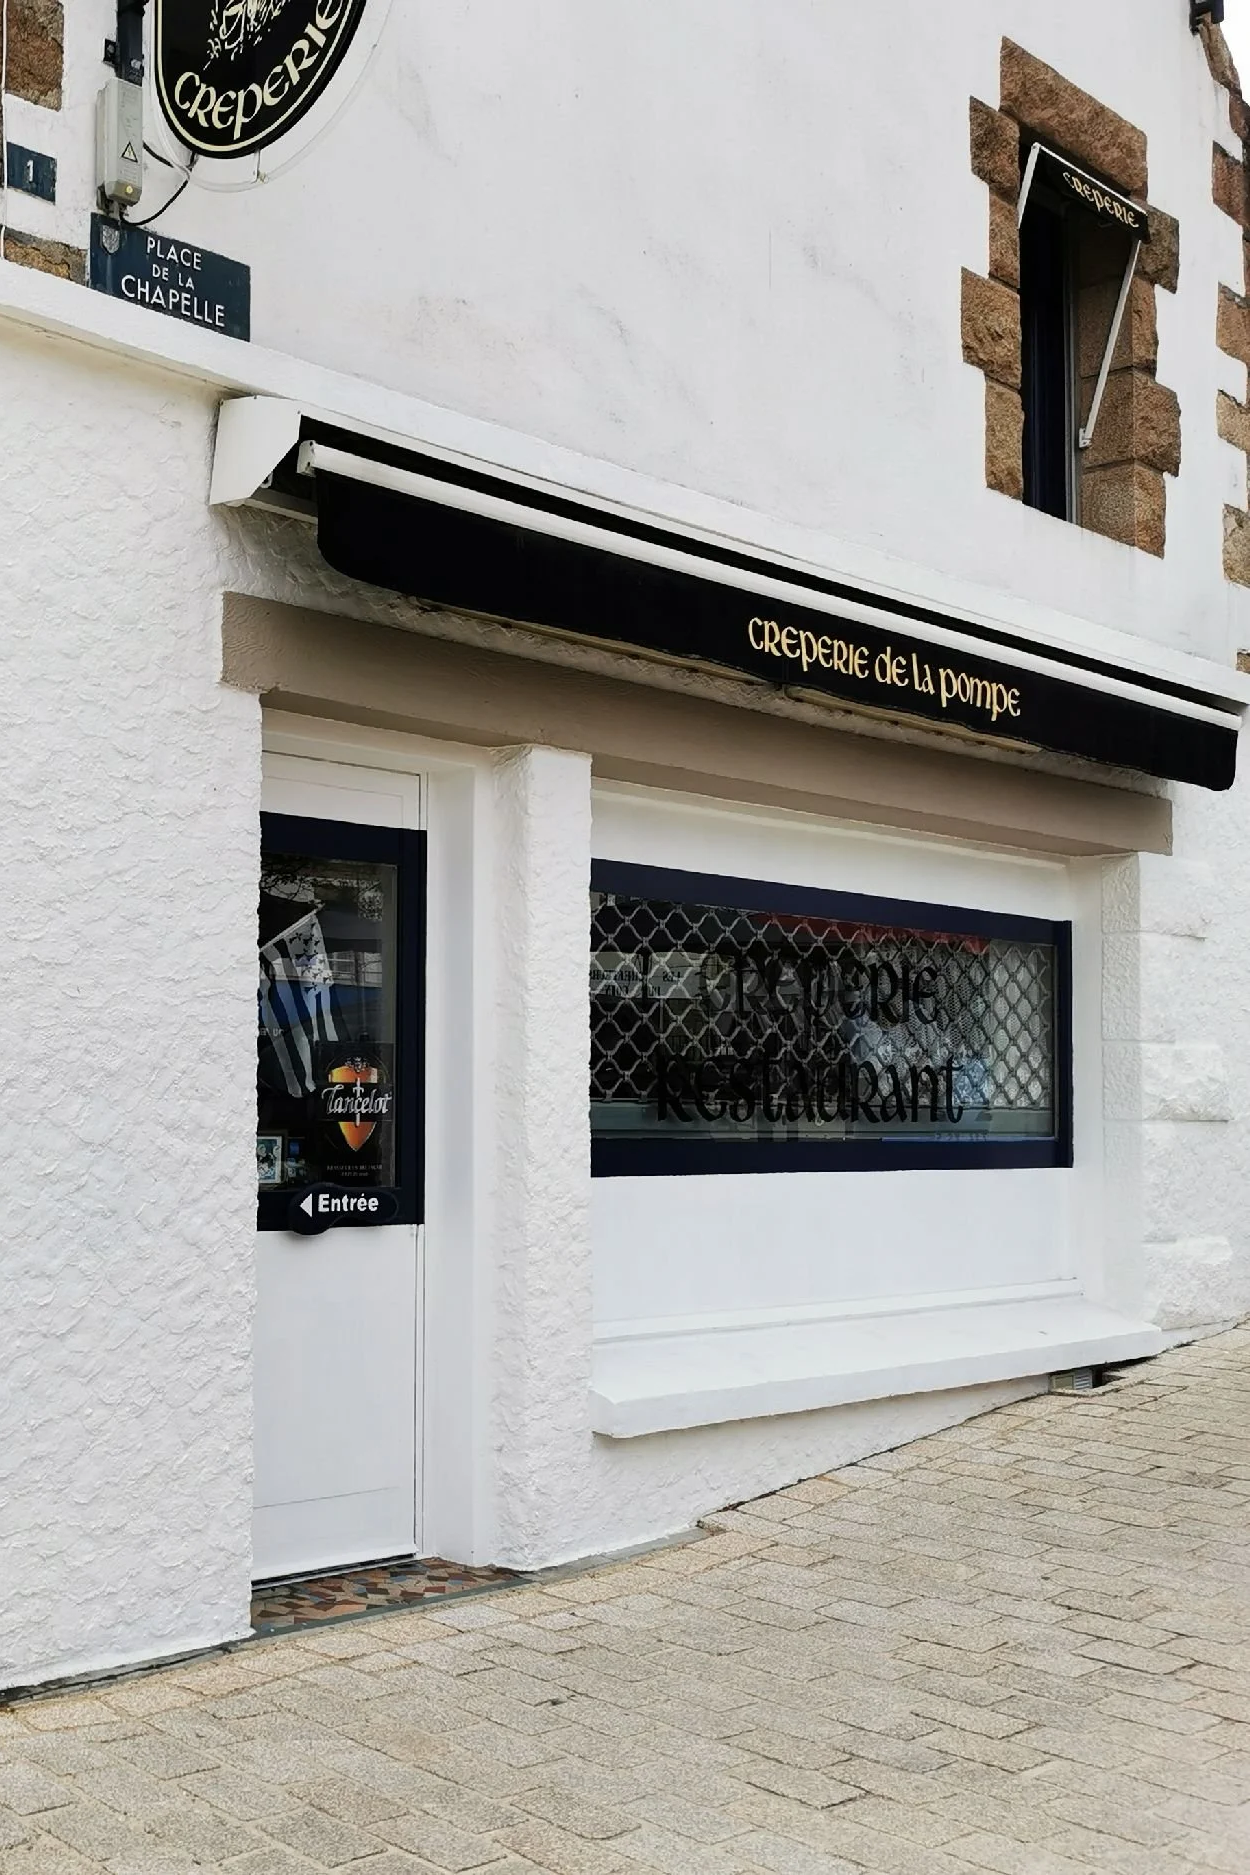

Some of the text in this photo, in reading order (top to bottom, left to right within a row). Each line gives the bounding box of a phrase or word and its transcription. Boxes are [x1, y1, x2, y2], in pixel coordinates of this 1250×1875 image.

[174, 0, 344, 140] CREPERIE
[26, 159, 34, 184] 1
[1062, 171, 1140, 228] CREPERIE
[146, 235, 202, 271] PLACE
[152, 263, 195, 291] DE LA
[121, 274, 225, 327] CHAPELLE
[748, 616, 1021, 722] CREPERIE de la pompe
[317, 1192, 379, 1212] Entrée
